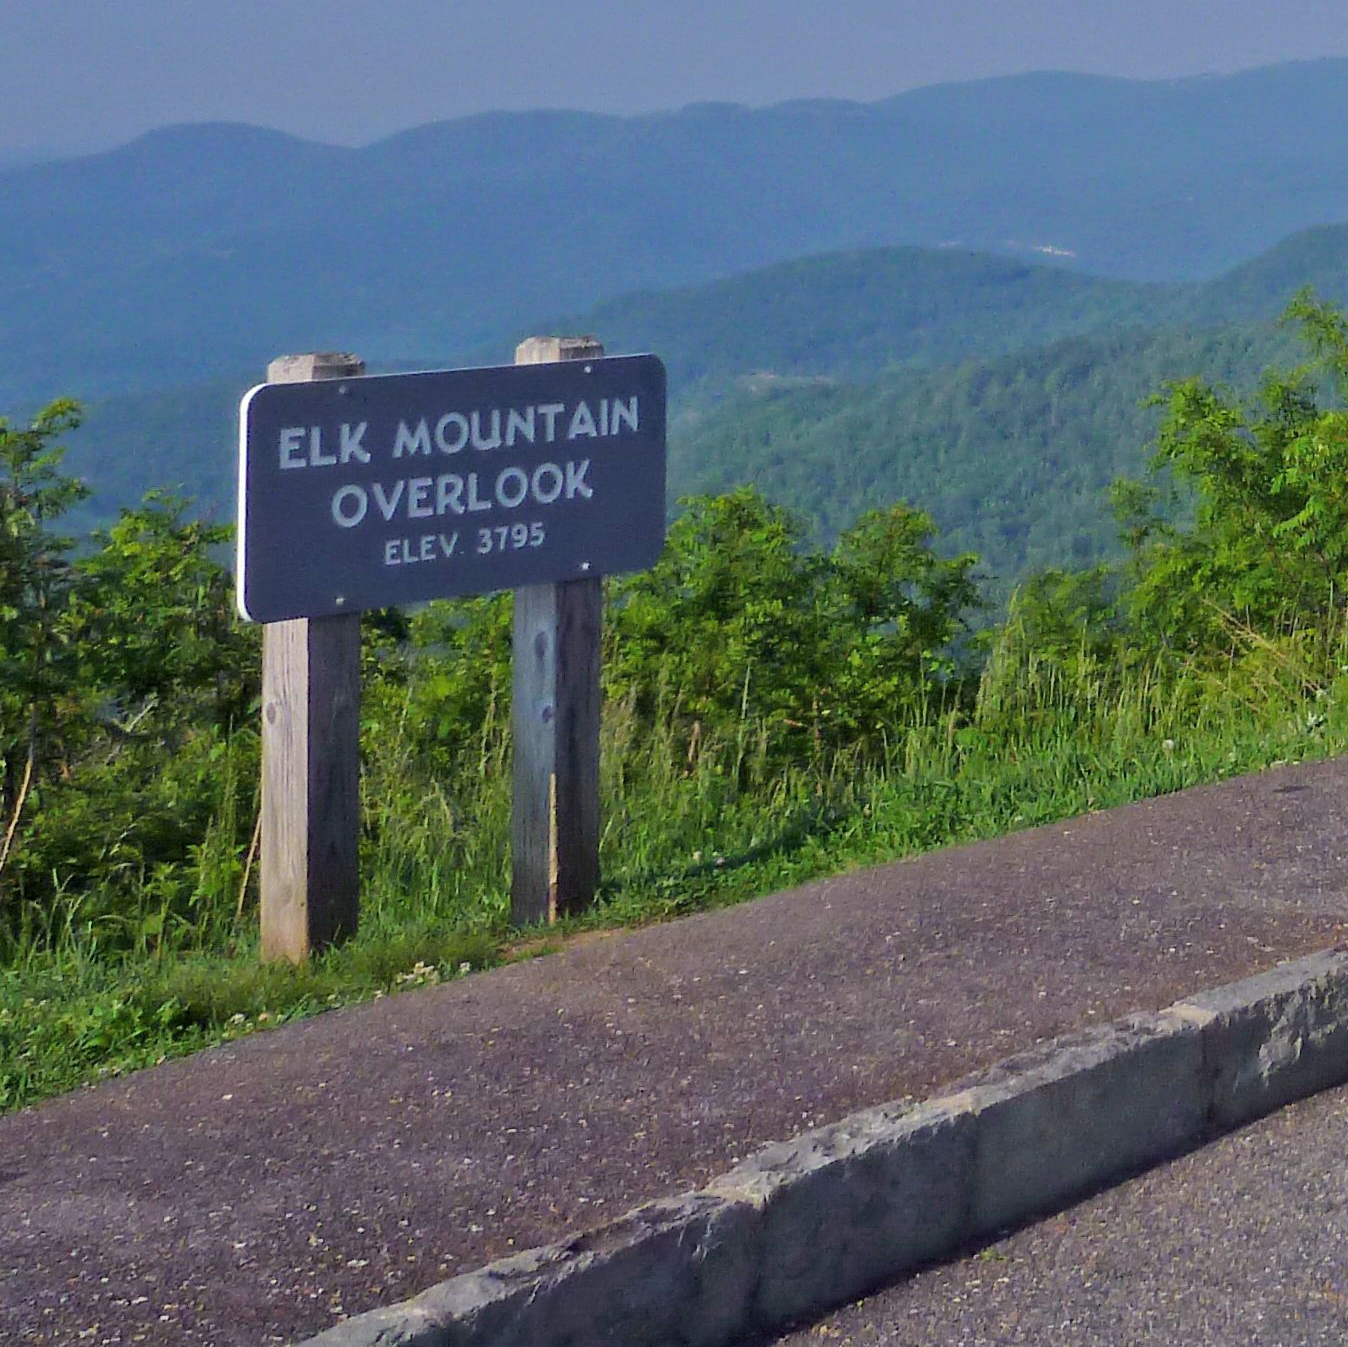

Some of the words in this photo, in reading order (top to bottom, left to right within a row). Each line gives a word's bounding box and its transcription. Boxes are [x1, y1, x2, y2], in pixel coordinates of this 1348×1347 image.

[280, 422, 371, 469] ELK
[393, 396, 639, 457] MOUNTAIN
[332, 459, 594, 527] OVERLOOK
[476, 521, 545, 554] 3795
